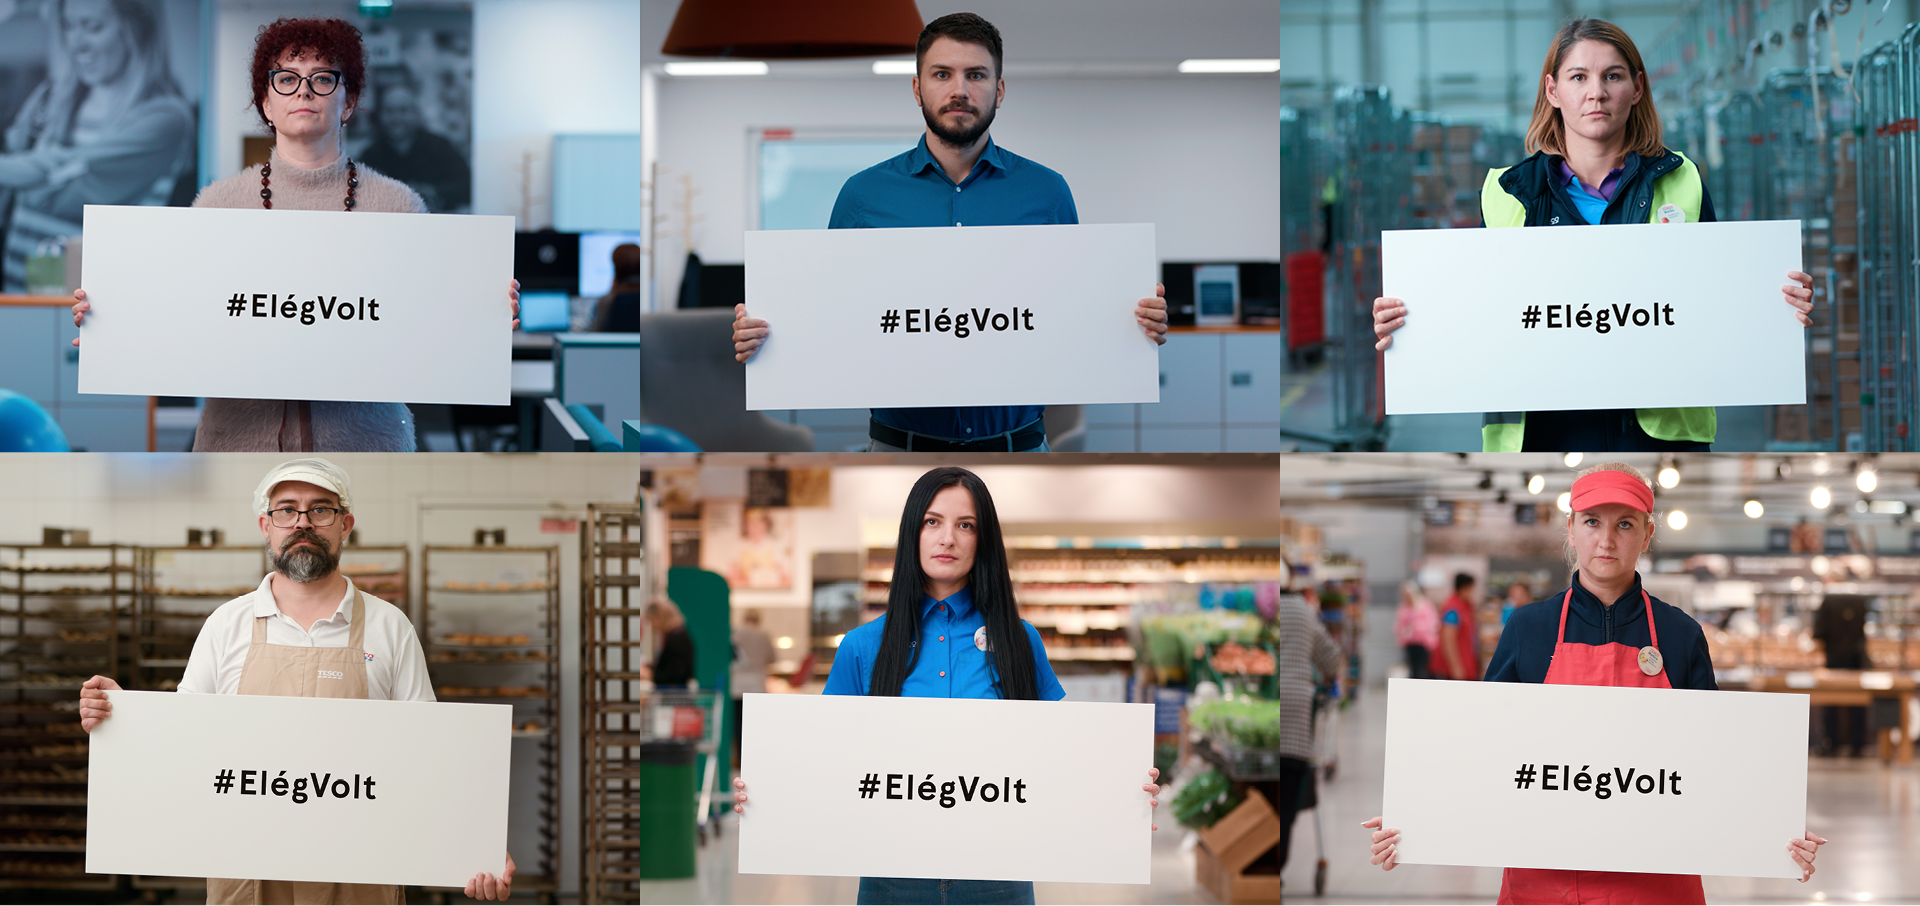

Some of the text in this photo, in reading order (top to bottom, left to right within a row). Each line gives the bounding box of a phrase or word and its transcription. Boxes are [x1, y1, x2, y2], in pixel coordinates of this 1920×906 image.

[226, 293, 380, 326] #ElégVolt
[879, 306, 1035, 339] #ElégVolt
[1521, 302, 1676, 334] #ElégVolt
[317, 670, 343, 678] TESCO
[213, 768, 377, 805] #ElégVolt
[858, 773, 1027, 809] #ElégVolt
[1514, 763, 1682, 800] #ElégVolt
